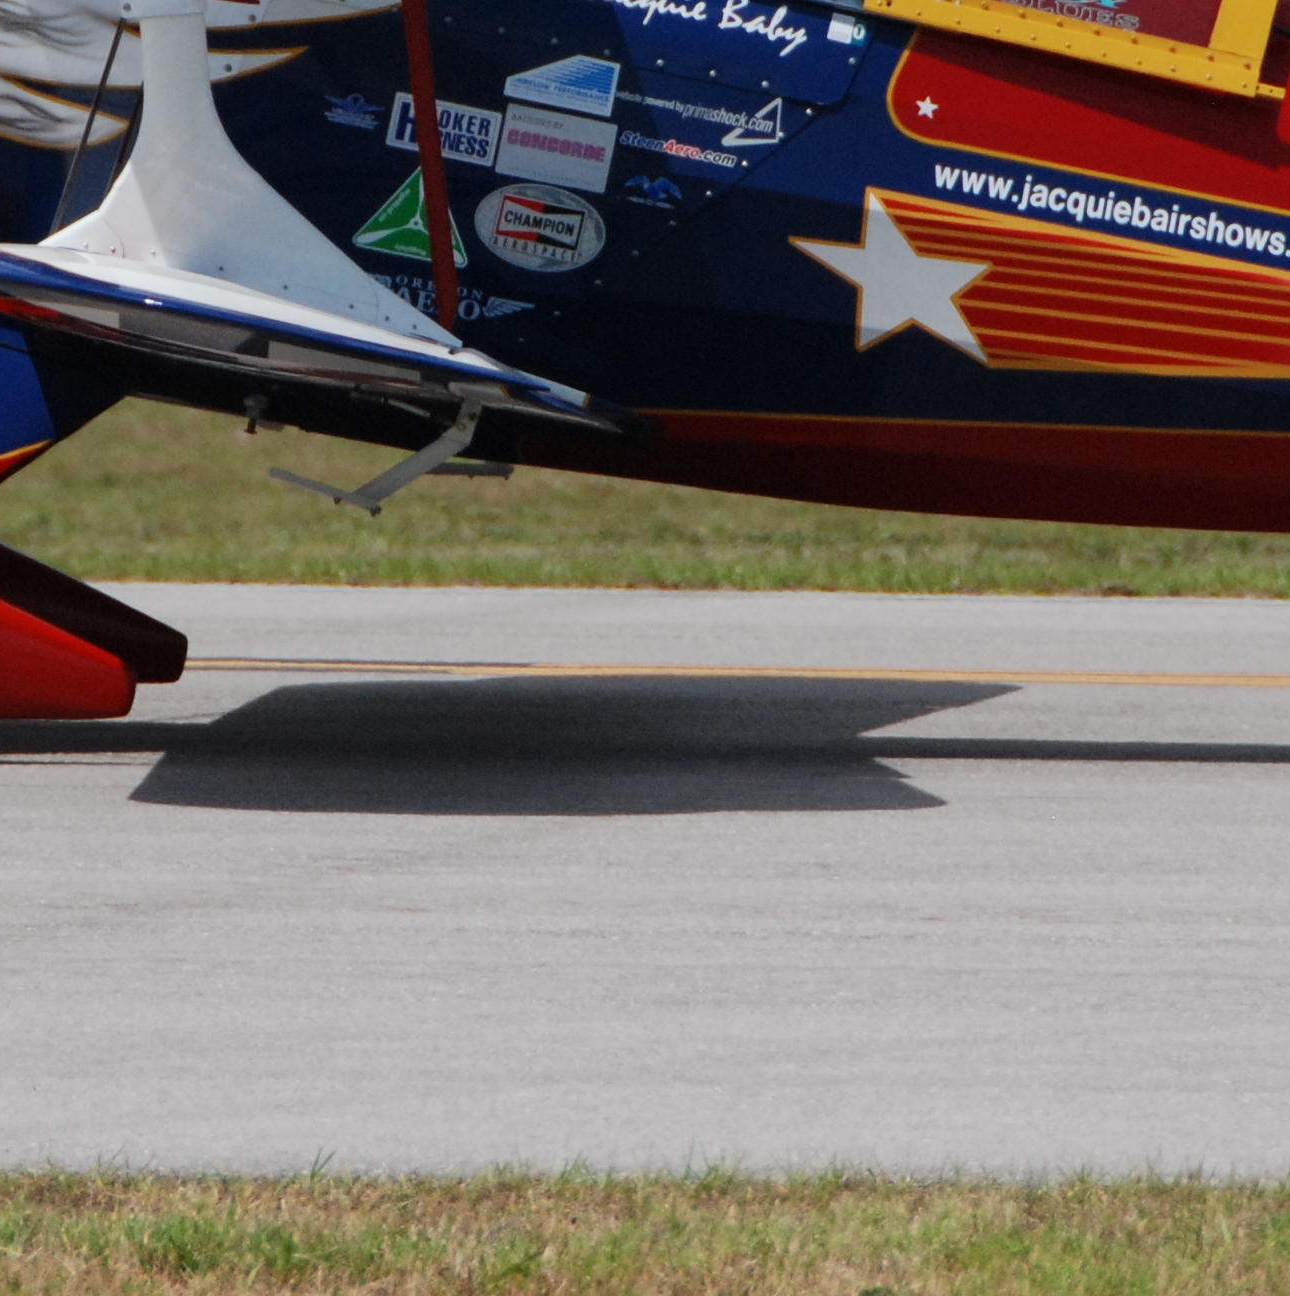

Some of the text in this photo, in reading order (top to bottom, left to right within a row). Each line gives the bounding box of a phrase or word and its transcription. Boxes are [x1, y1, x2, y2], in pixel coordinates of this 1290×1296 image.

[682, 104, 774, 133] primashock.com
[620, 130, 738, 168] SteenAero.com
[504, 210, 575, 237] CHAMPION
[493, 236, 578, 262] AEROSPACE
[396, 276, 484, 302] OREON
